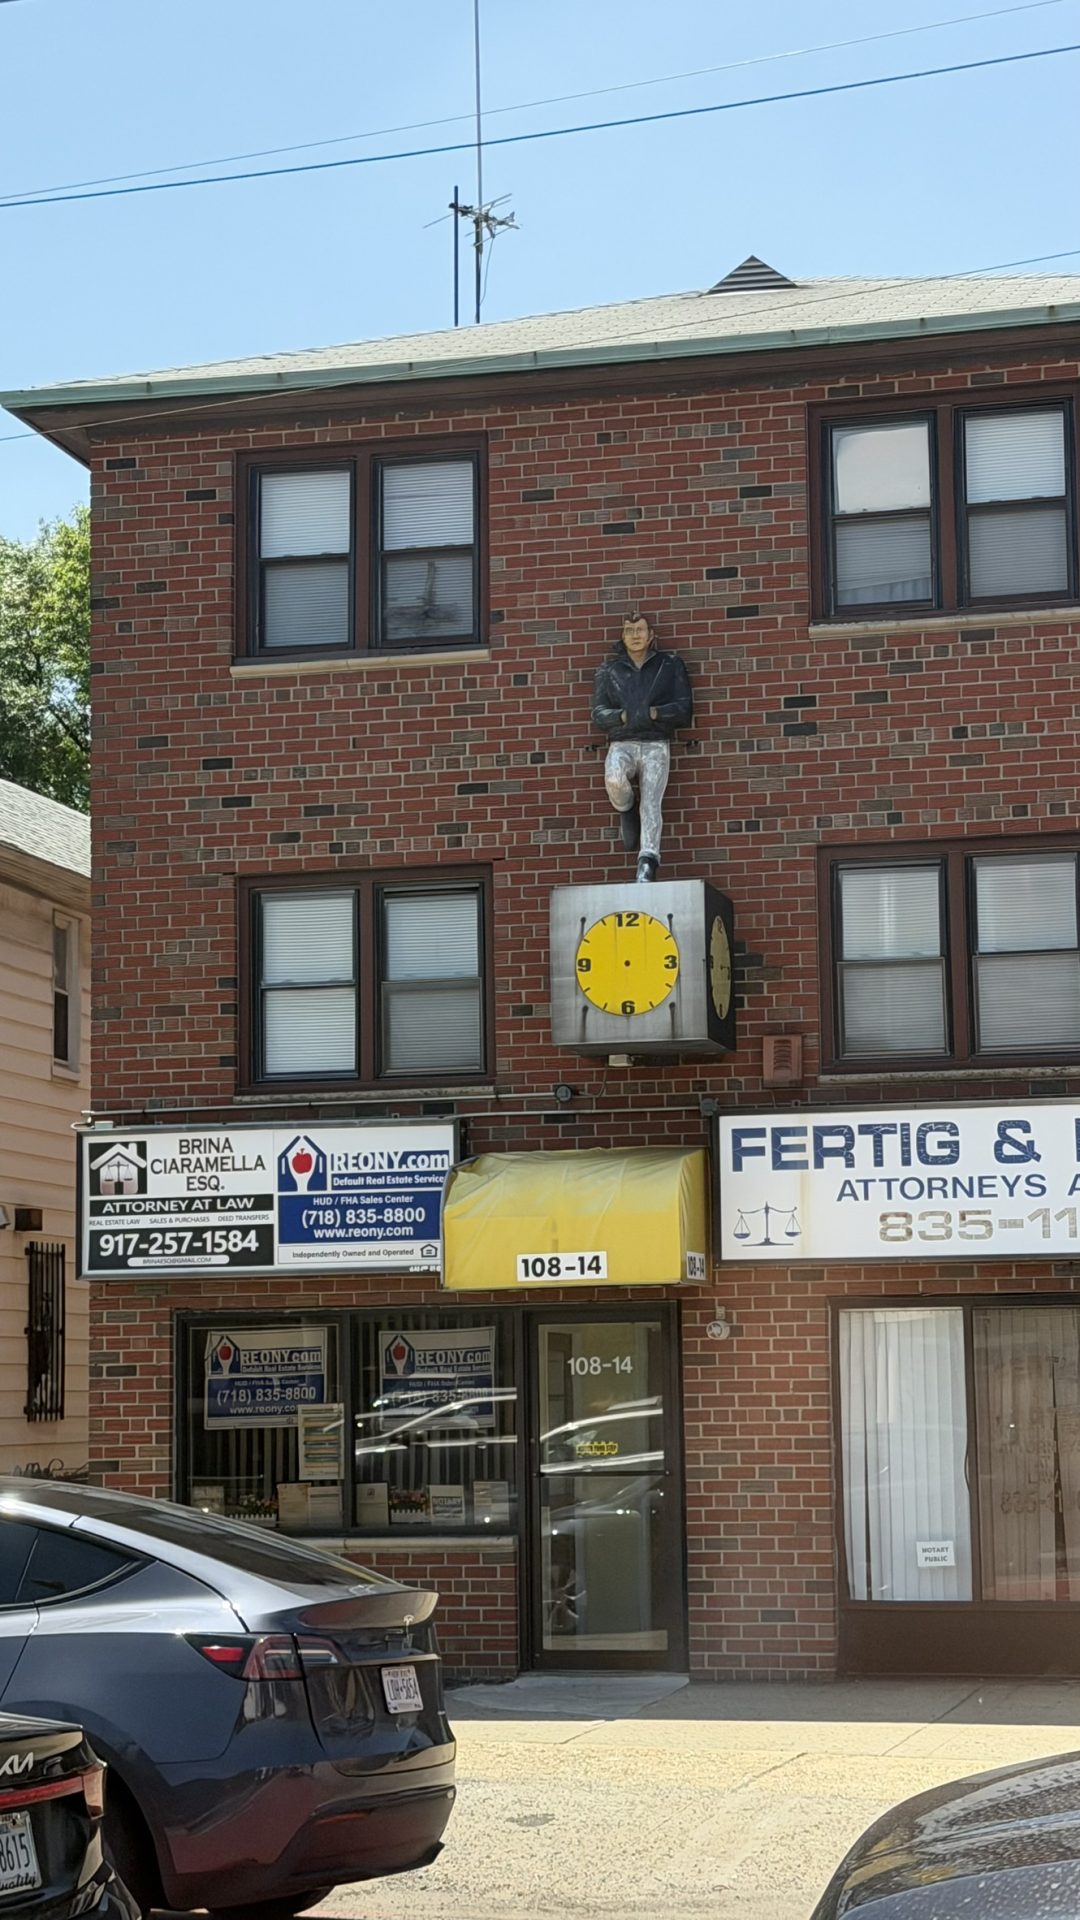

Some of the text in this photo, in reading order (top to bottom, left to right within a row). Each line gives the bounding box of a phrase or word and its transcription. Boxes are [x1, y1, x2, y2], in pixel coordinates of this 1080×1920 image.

[616, 912, 640, 927] 12
[577, 958, 592, 972] 9
[664, 954, 677, 970] 3
[621, 1000, 635, 1015] 6
[178, 1137, 234, 1155] BRINA
[731, 1121, 960, 1172] FERTIG
[993, 1119, 1041, 1164] &
[150, 1154, 266, 1175] CIARAMELLA
[333, 1150, 449, 1172] REONY.com
[186, 1175, 225, 1192] ESQ.
[333, 1177, 364, 1186] Default
[366, 1176, 386, 1185] Real
[386, 1174, 413, 1184] Estate
[836, 1174, 1048, 1202] ATTORNEYS
[102, 1198, 255, 1214] ATTORNEY AT LAW
[313, 1198, 333, 1206] HUD
[340, 1197, 358, 1205] FHA
[360, 1196, 383, 1204] Sales
[384, 1195, 414, 1204] Center
[174, 1216, 210, 1224] PURCHASES
[302, 1208, 426, 1228] (718) 835-8800
[314, 1226, 414, 1240] www.reony.com
[100, 1229, 259, 1257] 917-257-1584
[292, 1251, 340, 1259] Independently
[342, 1250, 366, 1258] Owned
[383, 1249, 414, 1257] Operated
[521, 1255, 602, 1278] 108-14
[567, 1356, 633, 1376] 108-14
[217, 1387, 316, 1406] (718) 835-8800
[230, 1404, 298, 1414] www.reony.co
